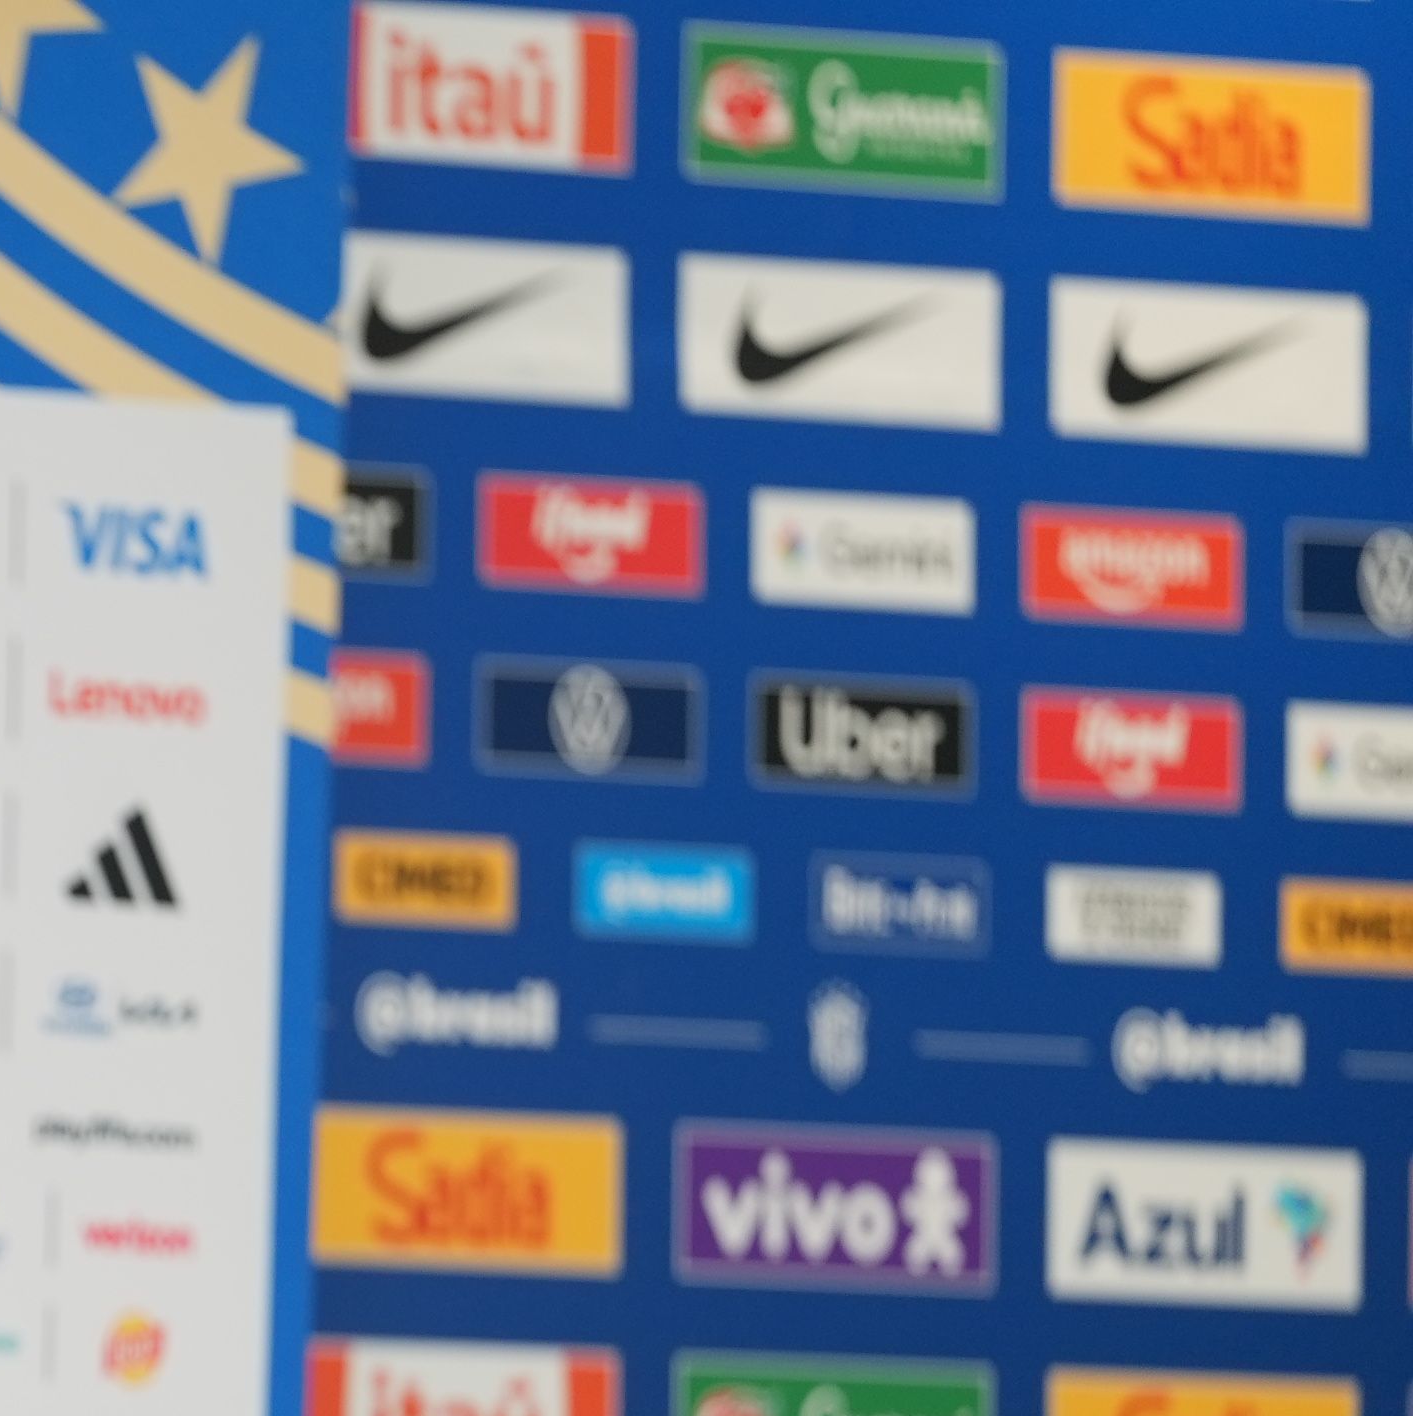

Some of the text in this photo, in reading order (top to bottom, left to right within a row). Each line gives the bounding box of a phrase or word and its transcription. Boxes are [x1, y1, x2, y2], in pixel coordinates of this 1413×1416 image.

[384, 36, 554, 149] itaú
[1121, 76, 1303, 200] Sadia
[67, 505, 207, 576] VISA
[50, 679, 205, 723] Lenovo
[773, 691, 943, 780] Uber
[363, 1129, 556, 1250] Sadia
[706, 1156, 893, 1260] vivo
[1080, 1184, 1245, 1269] Azul
